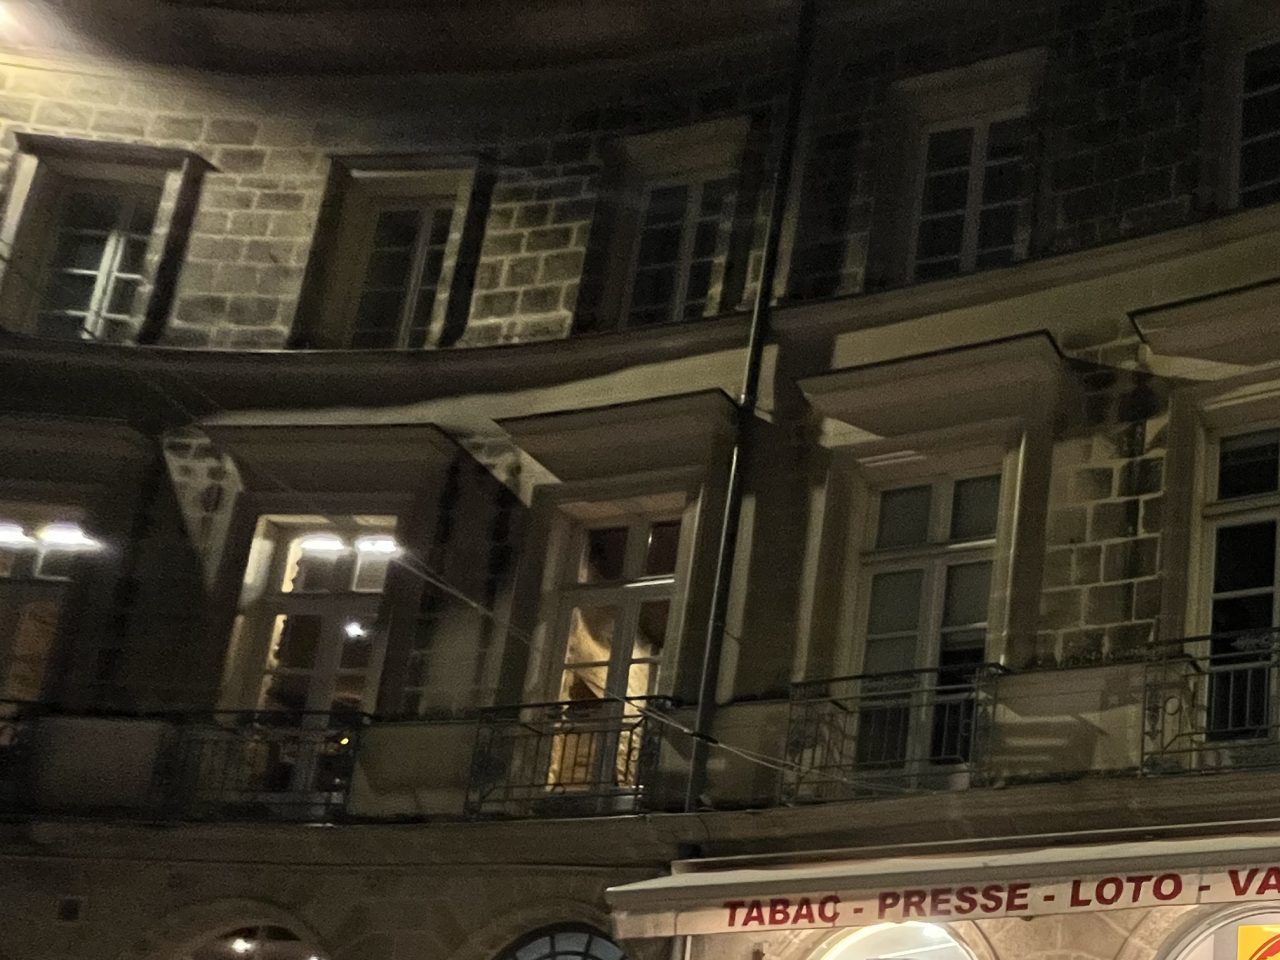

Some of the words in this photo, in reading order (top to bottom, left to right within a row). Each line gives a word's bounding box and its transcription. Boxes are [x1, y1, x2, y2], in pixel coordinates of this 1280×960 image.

[723, 894, 841, 927] TABAC
[877, 883, 1031, 919] PRESSE
[1070, 873, 1183, 907] LOTO
